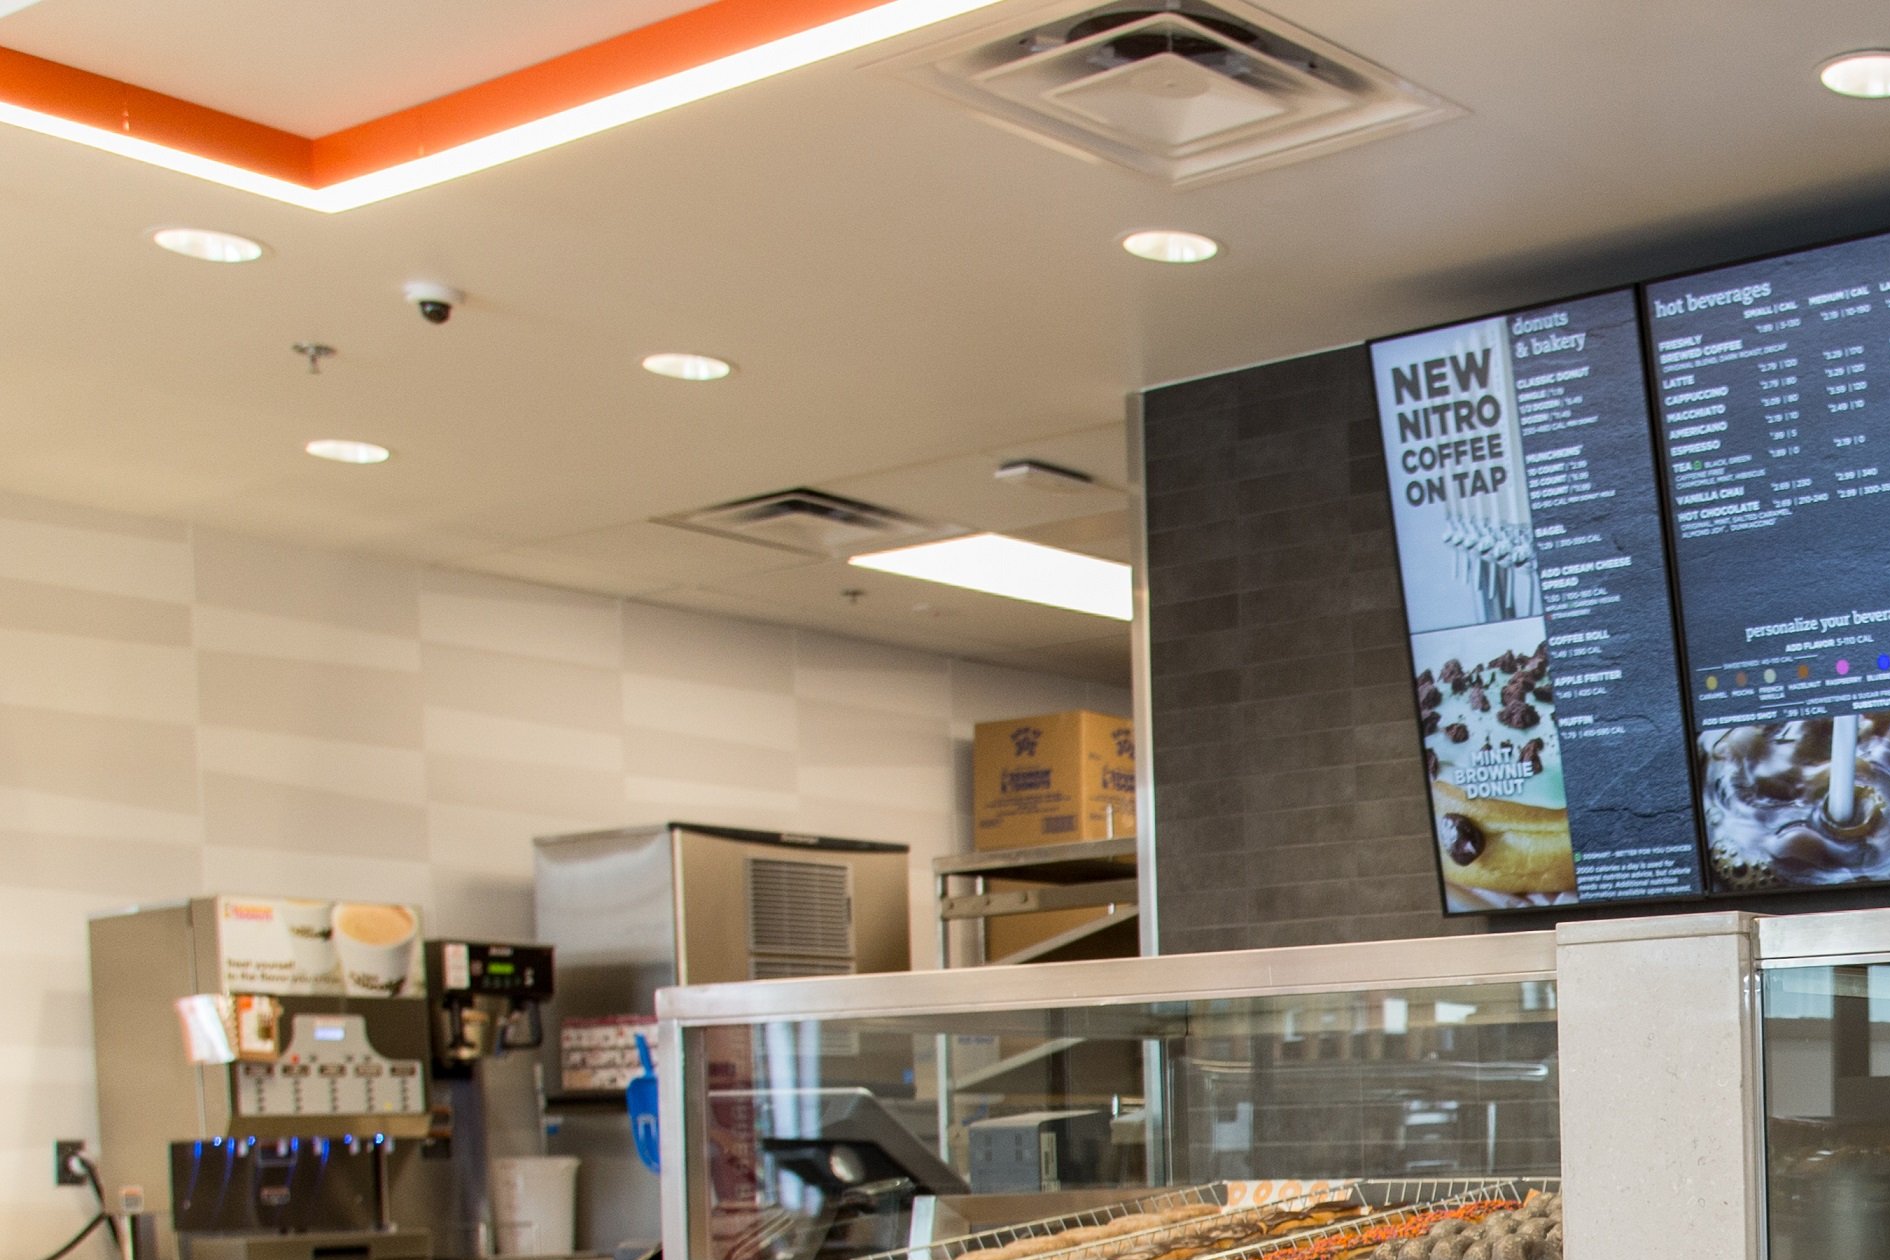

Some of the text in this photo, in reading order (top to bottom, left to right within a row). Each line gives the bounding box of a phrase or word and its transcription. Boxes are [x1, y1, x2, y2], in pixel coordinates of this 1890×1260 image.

[1654, 282, 1772, 318] hot beverages
[1513, 312, 1569, 335] donuts
[1516, 333, 1587, 358] & bakery
[1392, 349, 1492, 405] NEW
[1663, 376, 1695, 389] LATTE
[1397, 395, 1501, 442] NITRO
[1402, 434, 1504, 474] COFFEE
[1671, 440, 1721, 456] ESPRESSO
[1406, 477, 1446, 507] ON
[1453, 466, 1507, 500] TAP
[1745, 618, 1819, 641] personalize
[1821, 614, 1851, 633] your
[1472, 748, 1512, 766] MINT
[1455, 762, 1534, 784] BROWNIE
[1467, 780, 1526, 800] DONUT
